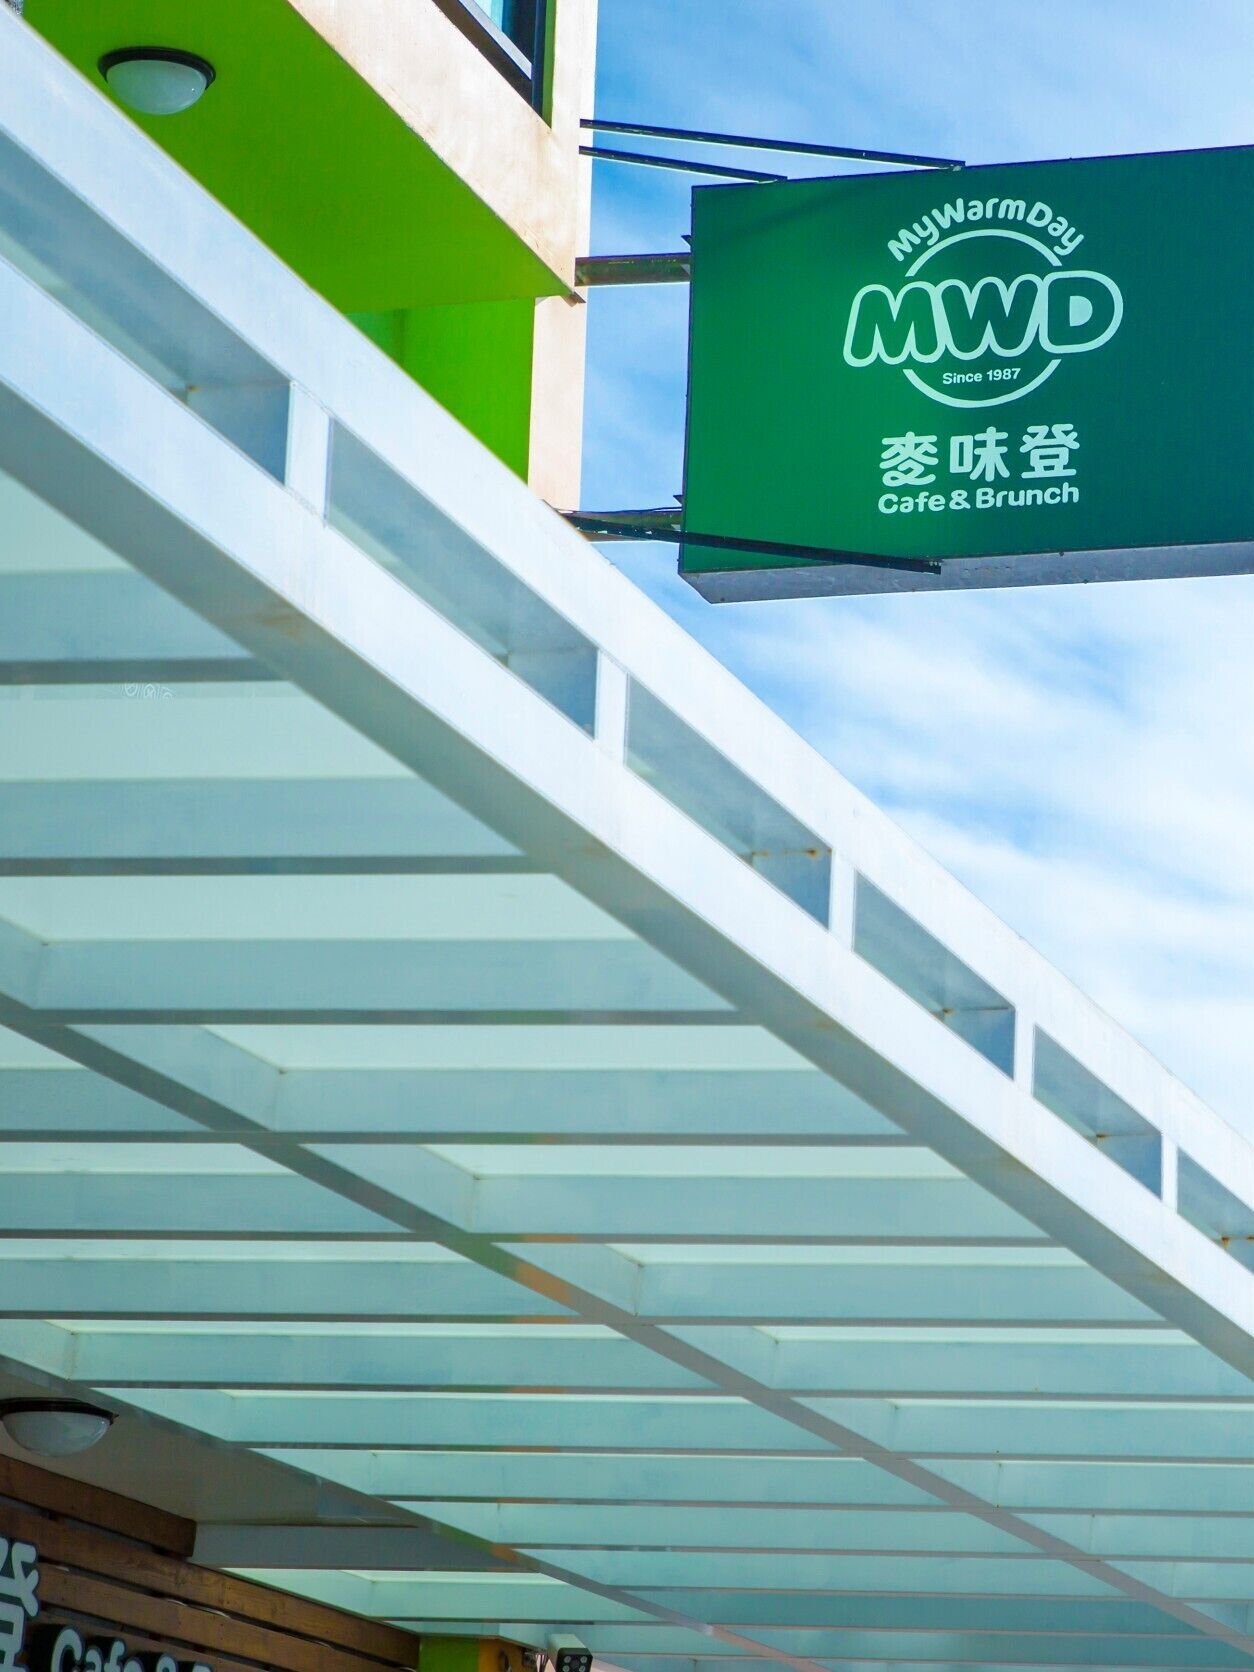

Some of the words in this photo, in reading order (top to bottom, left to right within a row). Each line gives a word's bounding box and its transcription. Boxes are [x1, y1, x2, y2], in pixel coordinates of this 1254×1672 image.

[842, 270, 1124, 368] MWD
[942, 371, 984, 385] Since
[986, 368, 1021, 382] 1987
[878, 423, 1080, 487] 麥味登
[877, 489, 946, 514] Cafe
[949, 489, 971, 510] &
[975, 481, 1080, 509] Brunch
